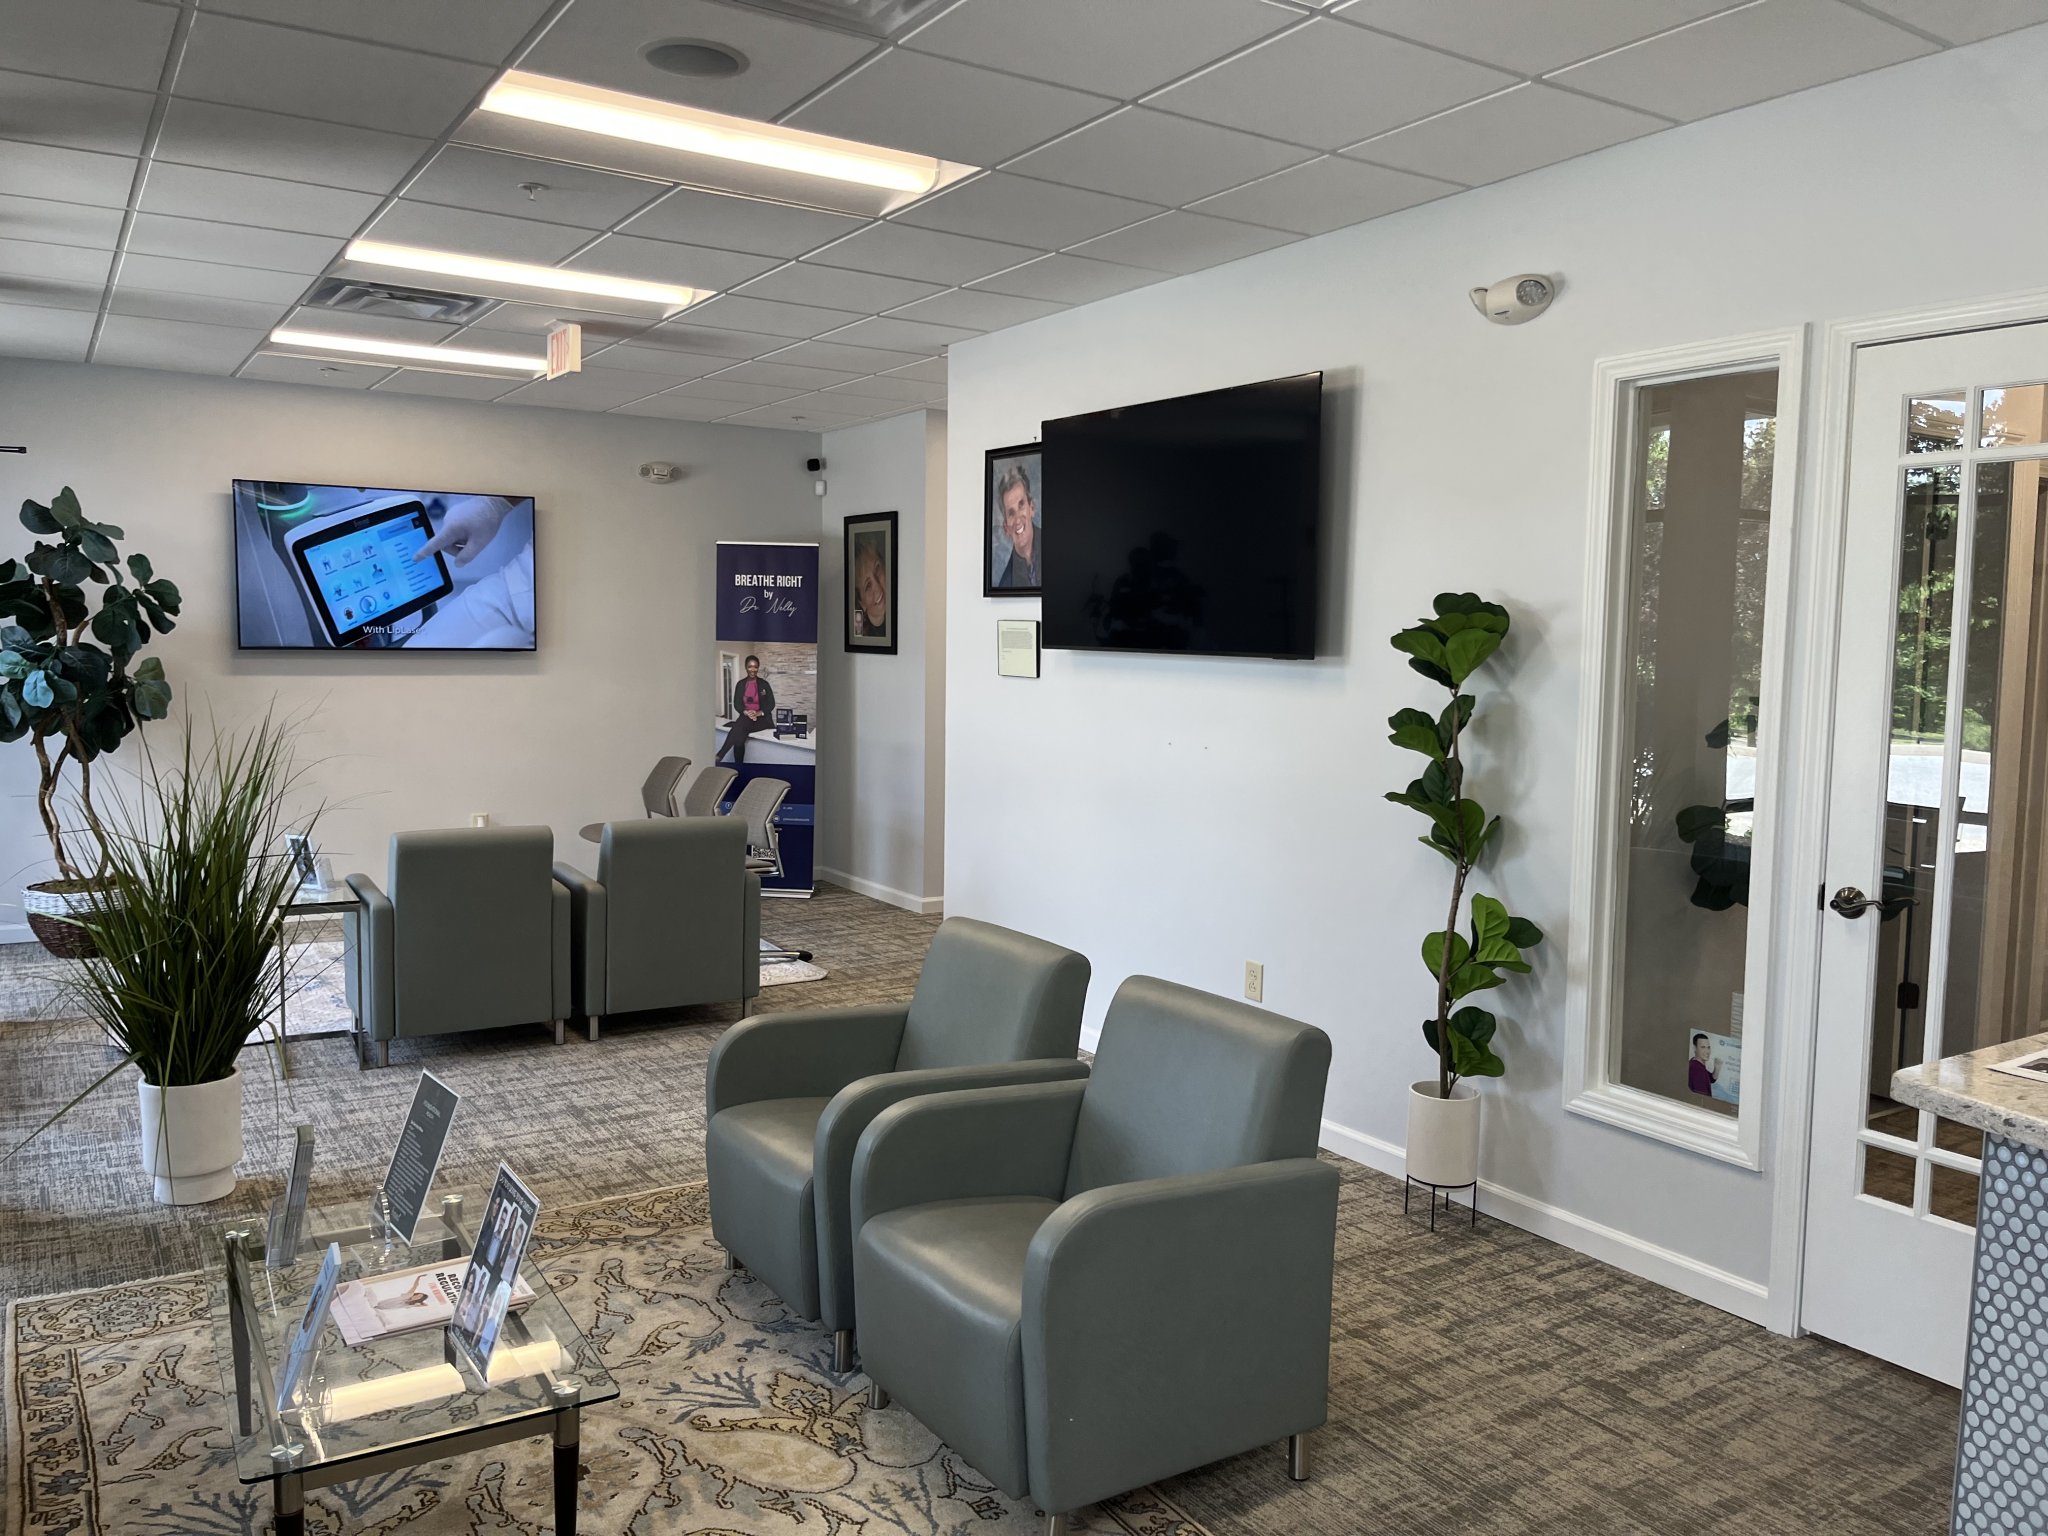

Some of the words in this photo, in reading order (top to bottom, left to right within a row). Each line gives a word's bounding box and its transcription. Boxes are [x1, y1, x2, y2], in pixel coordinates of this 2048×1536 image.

[551, 329, 567, 375] EXIT
[735, 574, 775, 587] BREATHE
[776, 575, 803, 588] RIGHT
[763, 589, 774, 600] by
[765, 597, 798, 617] Nelly
[363, 626, 385, 634] With
